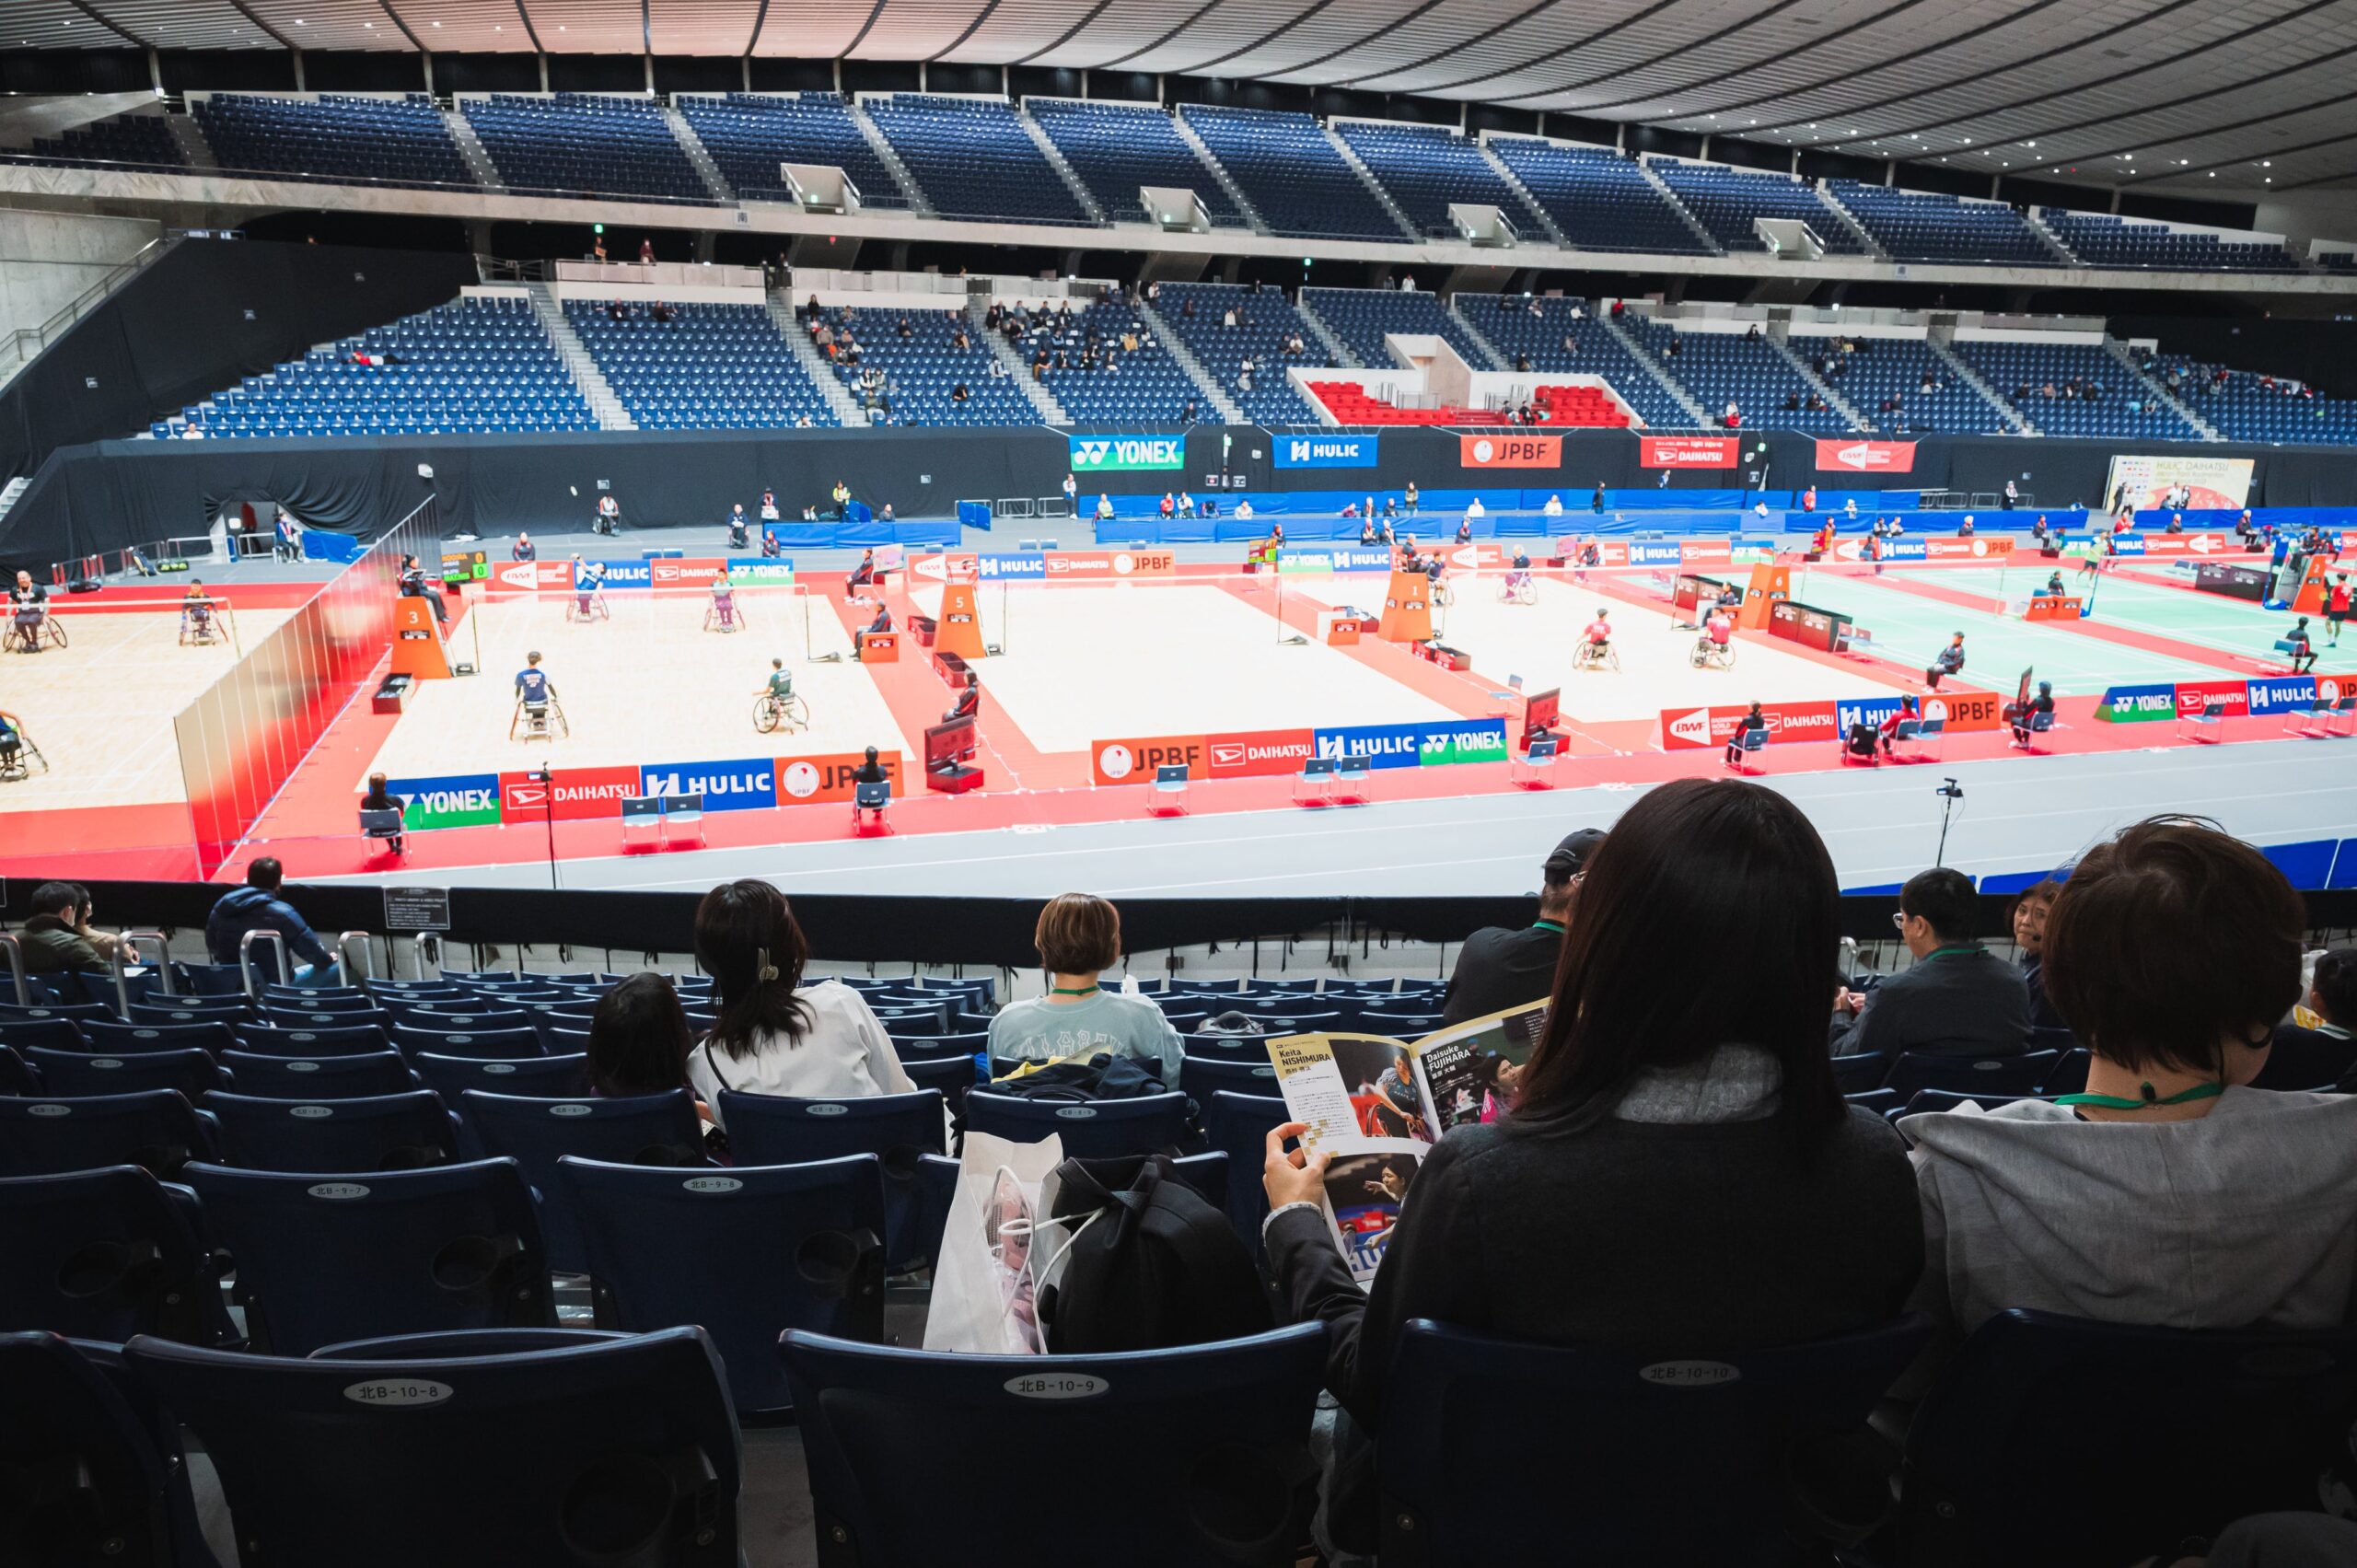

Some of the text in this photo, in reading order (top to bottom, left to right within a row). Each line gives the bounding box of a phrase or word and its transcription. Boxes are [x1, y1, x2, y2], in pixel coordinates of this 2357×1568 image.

[1114, 441, 1179, 464] YONEX
[1313, 445, 1359, 458] HULIC
[1499, 443, 1548, 459] JPBF
[1678, 451, 1723, 462] DAIHATSU
[1895, 544, 1925, 554] HULIC
[1987, 541, 2014, 553] JPBF
[2116, 540, 2144, 551] HULIC
[475, 552, 483, 563] 0
[1352, 554, 1389, 564] HULIC
[1646, 548, 1680, 558] HULIC
[478, 565, 484, 575] 0
[1000, 560, 1044, 573] HULIC
[1133, 556, 1172, 571] JPBF
[2313, 563, 2320, 574] 2
[679, 567, 719, 578] DAIHATS
[751, 564, 791, 578] YONEX
[1775, 575, 1783, 587] 6
[1412, 586, 1419, 596] 1
[955, 597, 964, 608] 5
[408, 611, 419, 624] 3
[2203, 692, 2246, 705] DAIHATSU
[2271, 687, 2316, 703] HULIC
[2136, 694, 2173, 711] YONEX
[1949, 702, 1995, 722] JPBF
[1676, 722, 1705, 733] BWF
[1783, 714, 1835, 728] DAIHATSU
[1351, 736, 1416, 755] HULIC
[1452, 731, 1504, 751] YONEX
[1248, 744, 1312, 760] DAIHATSU
[1133, 746, 1200, 772] JPBF
[688, 773, 772, 796] HULIC
[553, 784, 636, 802] DAIHATSU
[419, 788, 493, 814] YONEX
[1279, 1049, 1302, 1058] Keita
[1282, 1053, 1331, 1066] NISHIMURA
[1427, 1045, 1459, 1063] Daisuke
[1429, 1049, 1471, 1072] FUJIHARA
[316, 1186, 362, 1196] 北B-9-7
[691, 1179, 736, 1190] 北B-9-8
[1650, 1366, 1729, 1379] 北B-10-10
[1019, 1378, 1096, 1393] 北B-10-9
[358, 1385, 438, 1400] 北B-10-8
